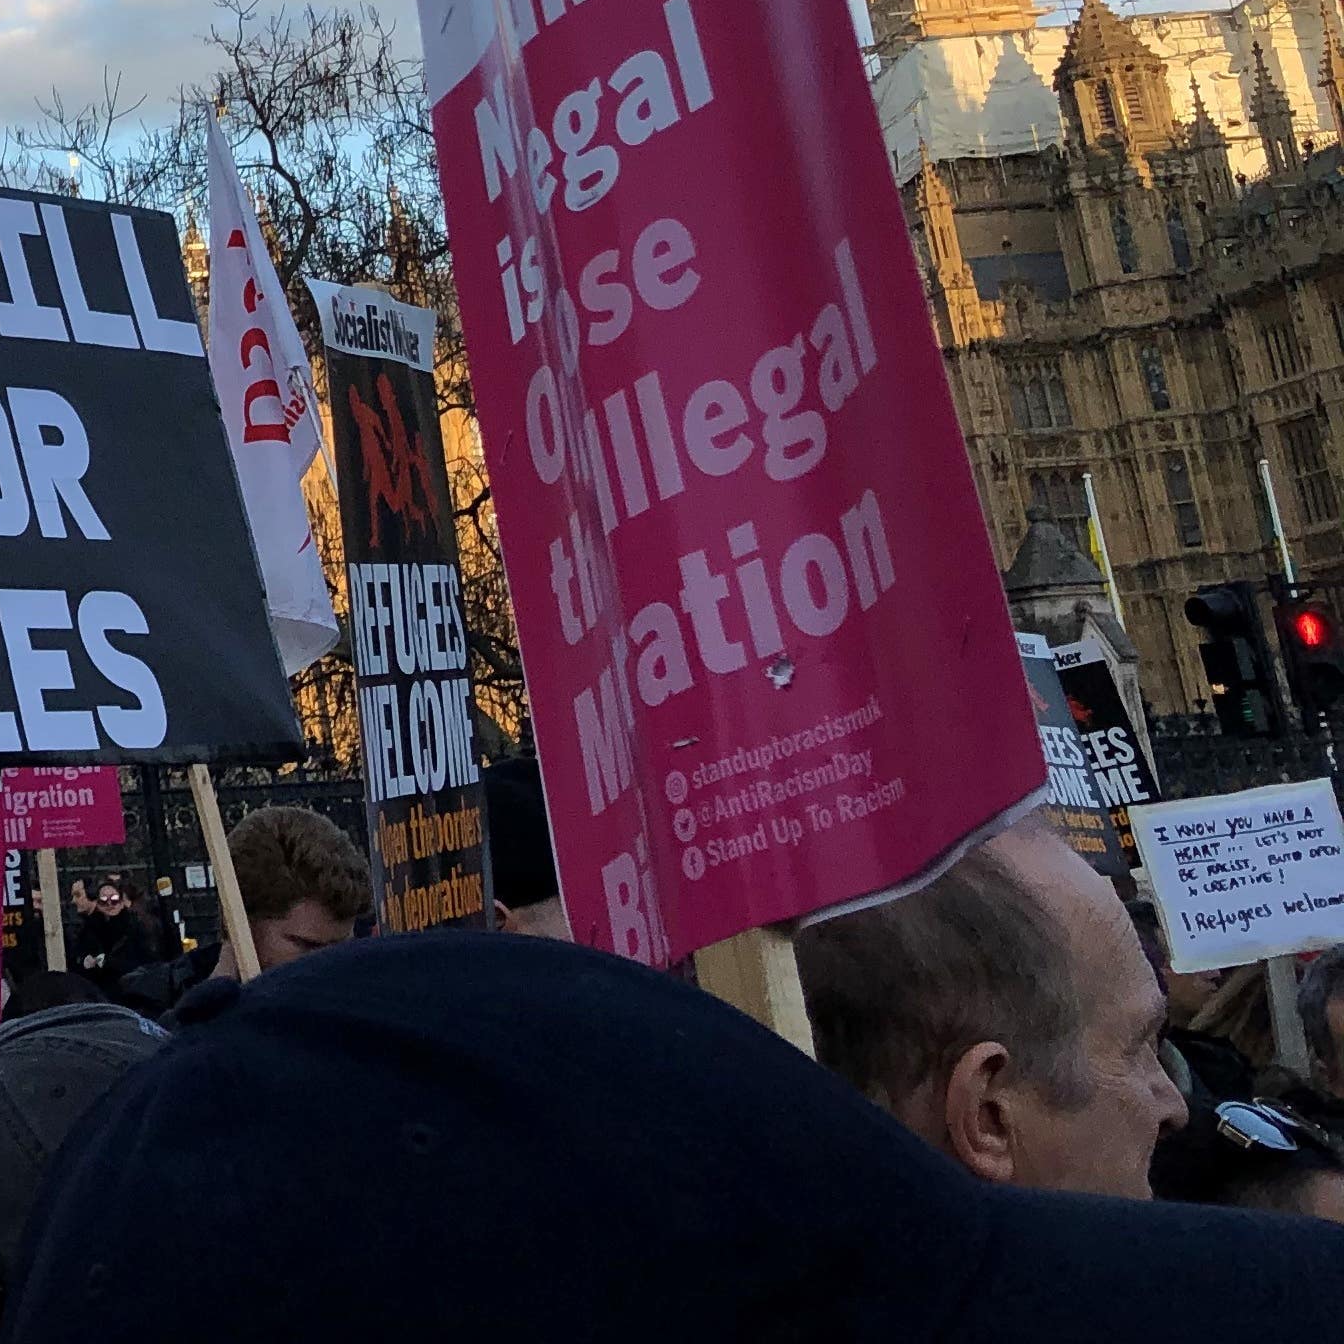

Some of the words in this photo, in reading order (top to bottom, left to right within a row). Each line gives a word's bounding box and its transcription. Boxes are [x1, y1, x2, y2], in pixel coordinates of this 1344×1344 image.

[496, 233, 544, 345] is
[349, 562, 466, 676] REFUGEES
[360, 678, 479, 803] WELCOME
[3, 784, 95, 816] igration
[697, 750, 873, 828] @AntiRacismDay
[705, 823, 768, 867] Stand
[771, 816, 803, 846] Up
[806, 803, 834, 833] To
[837, 777, 906, 823] Racism
[1154, 826, 1169, 842] I
[1175, 820, 1216, 838] KNOW
[1226, 817, 1253, 839] YOU
[1304, 807, 1313, 821] A
[1178, 867, 1199, 882] BE
[1309, 845, 1341, 859] OPEN
[1297, 828, 1324, 840] NOT
